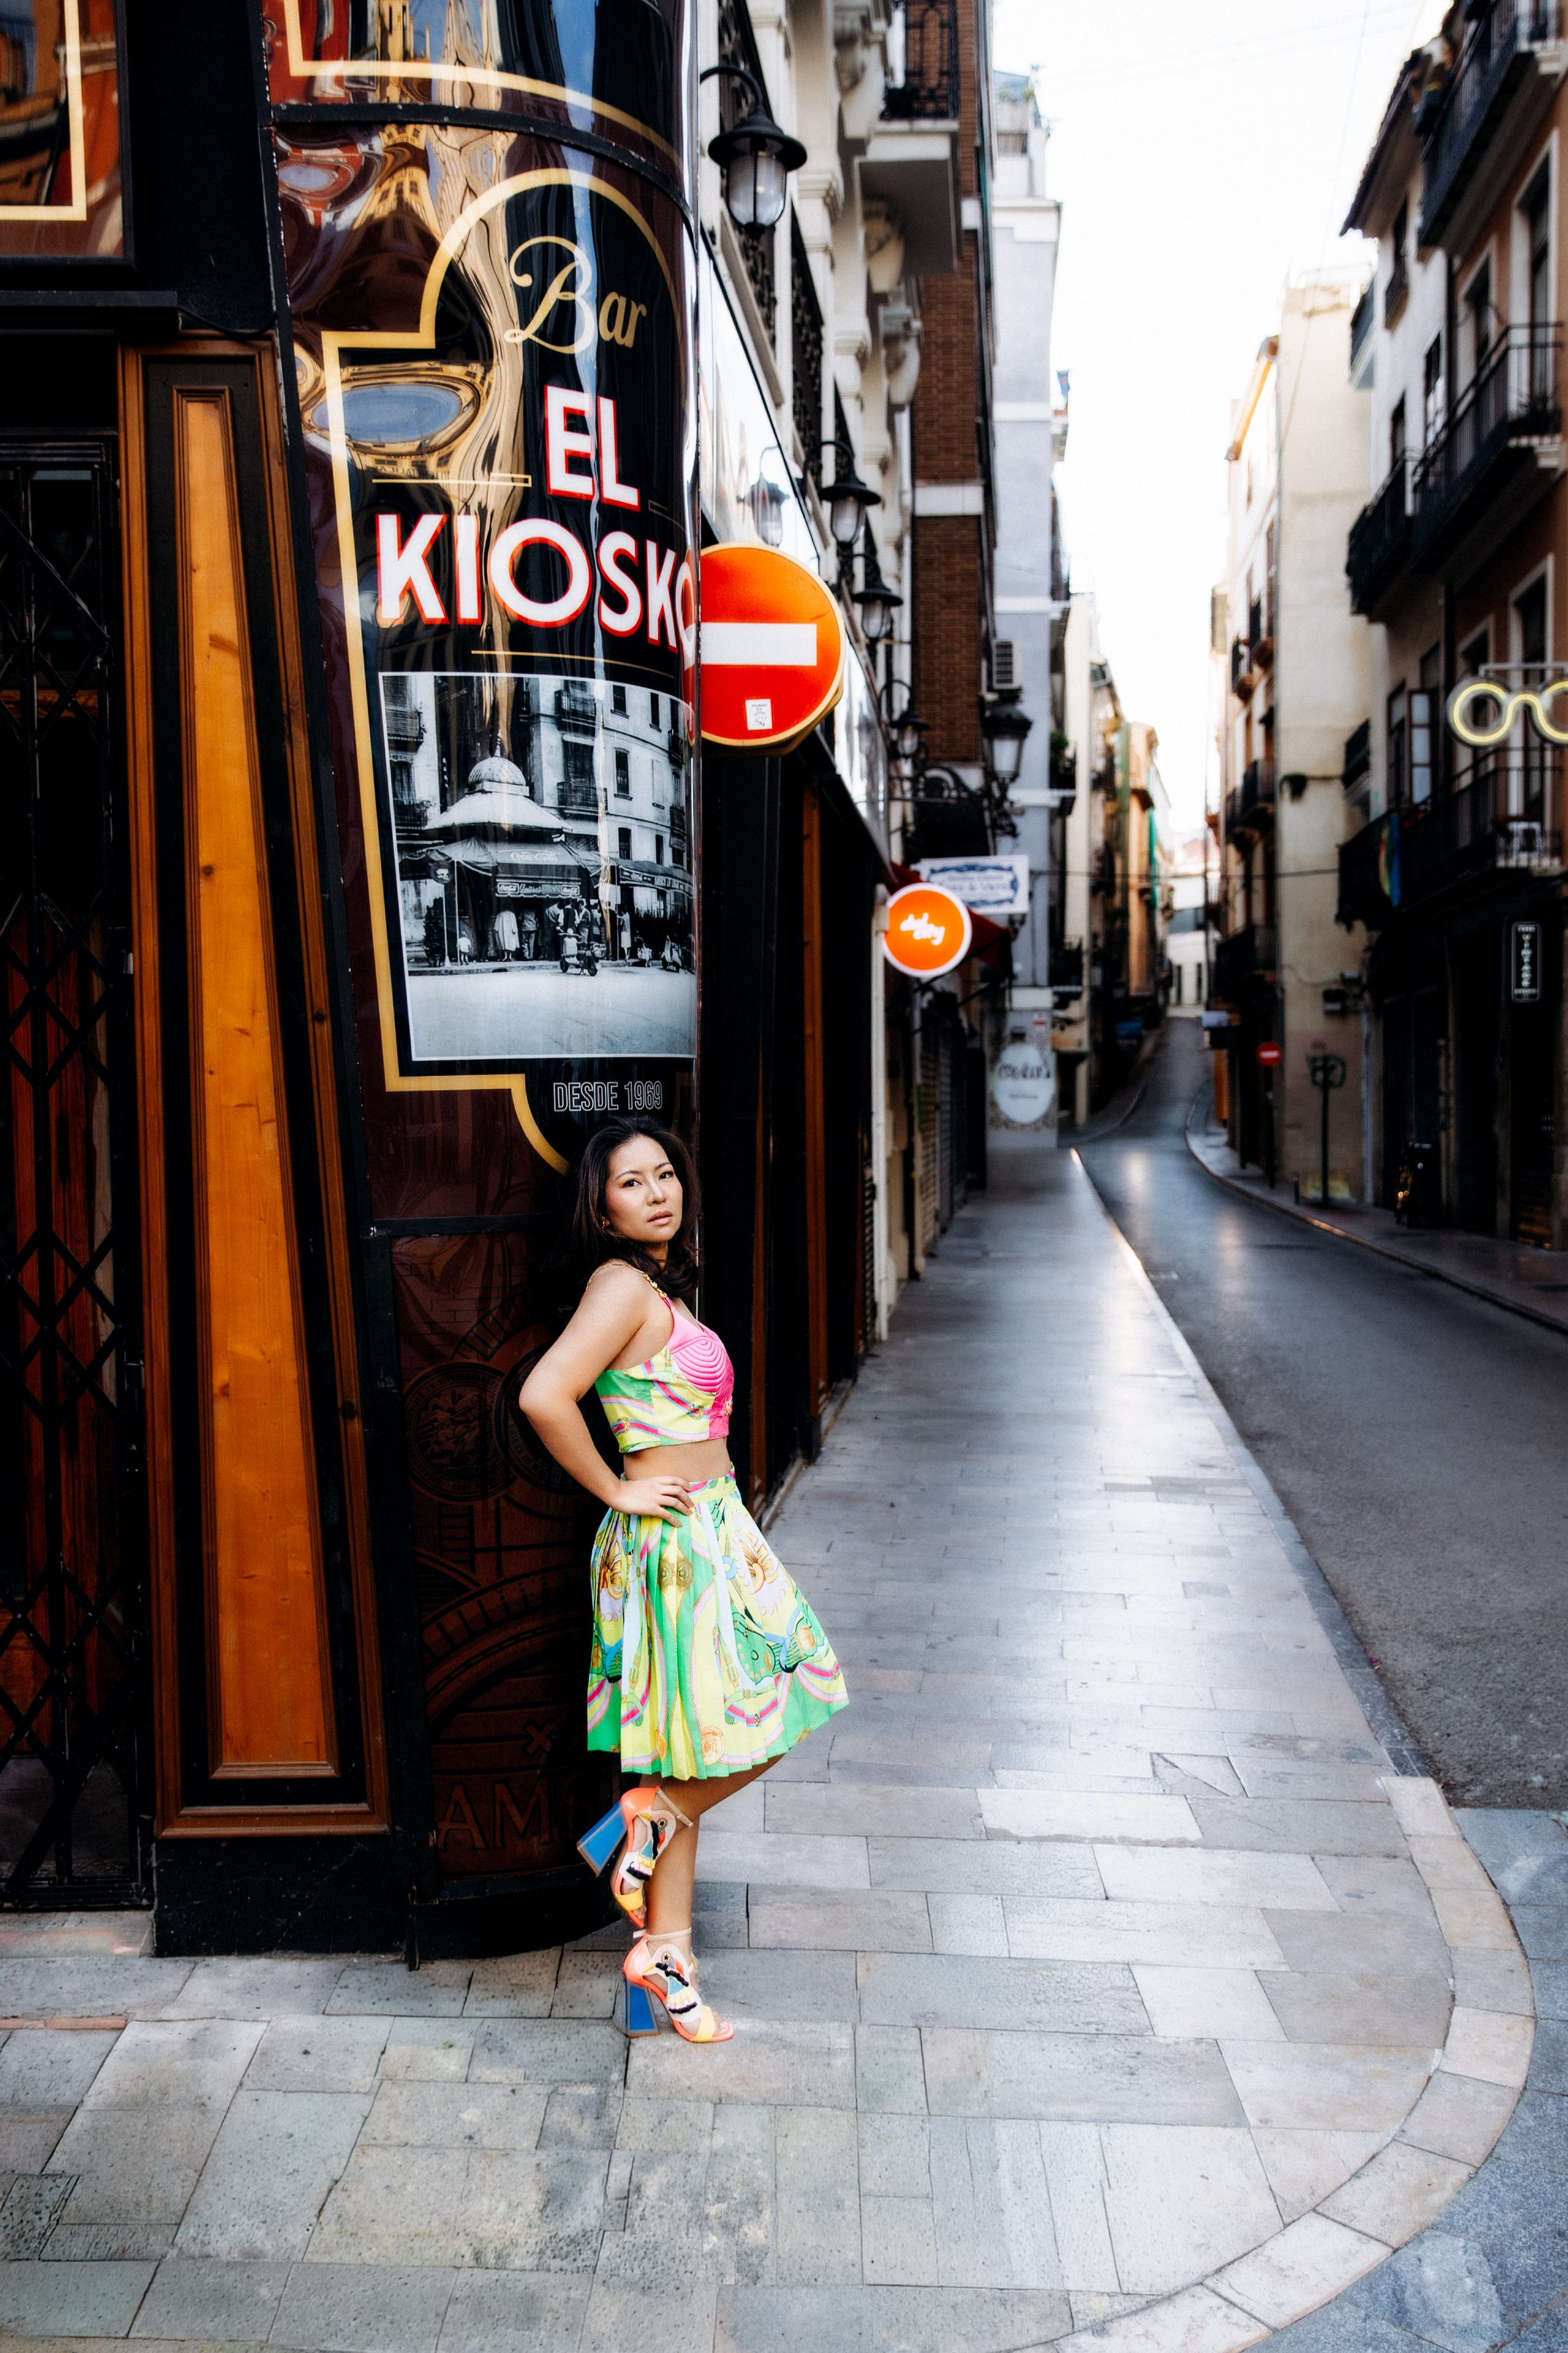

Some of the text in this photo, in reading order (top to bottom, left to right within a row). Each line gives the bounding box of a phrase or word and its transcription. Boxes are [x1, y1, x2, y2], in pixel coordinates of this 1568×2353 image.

[504, 236, 647, 355] Bar
[545, 385, 641, 512] EL
[375, 513, 697, 671] KIOSKO
[553, 1080, 663, 1112] DESDE 1969
